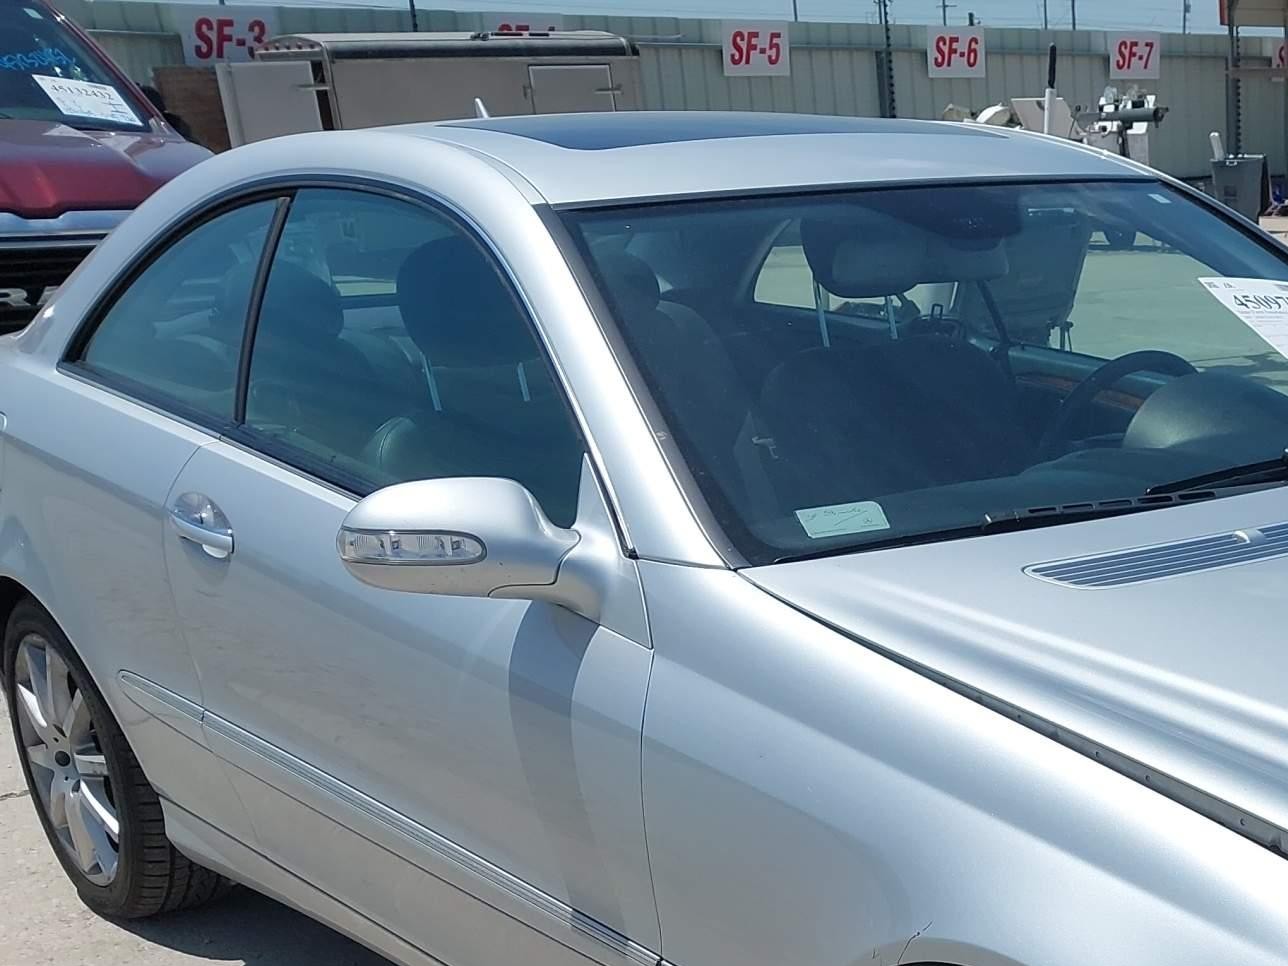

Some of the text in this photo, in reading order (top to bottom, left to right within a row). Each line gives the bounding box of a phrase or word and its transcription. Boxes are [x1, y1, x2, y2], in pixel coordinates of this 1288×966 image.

[731, 31, 781, 65] SF-5
[934, 36, 979, 67] SF-6
[1116, 41, 1154, 70] SF-7
